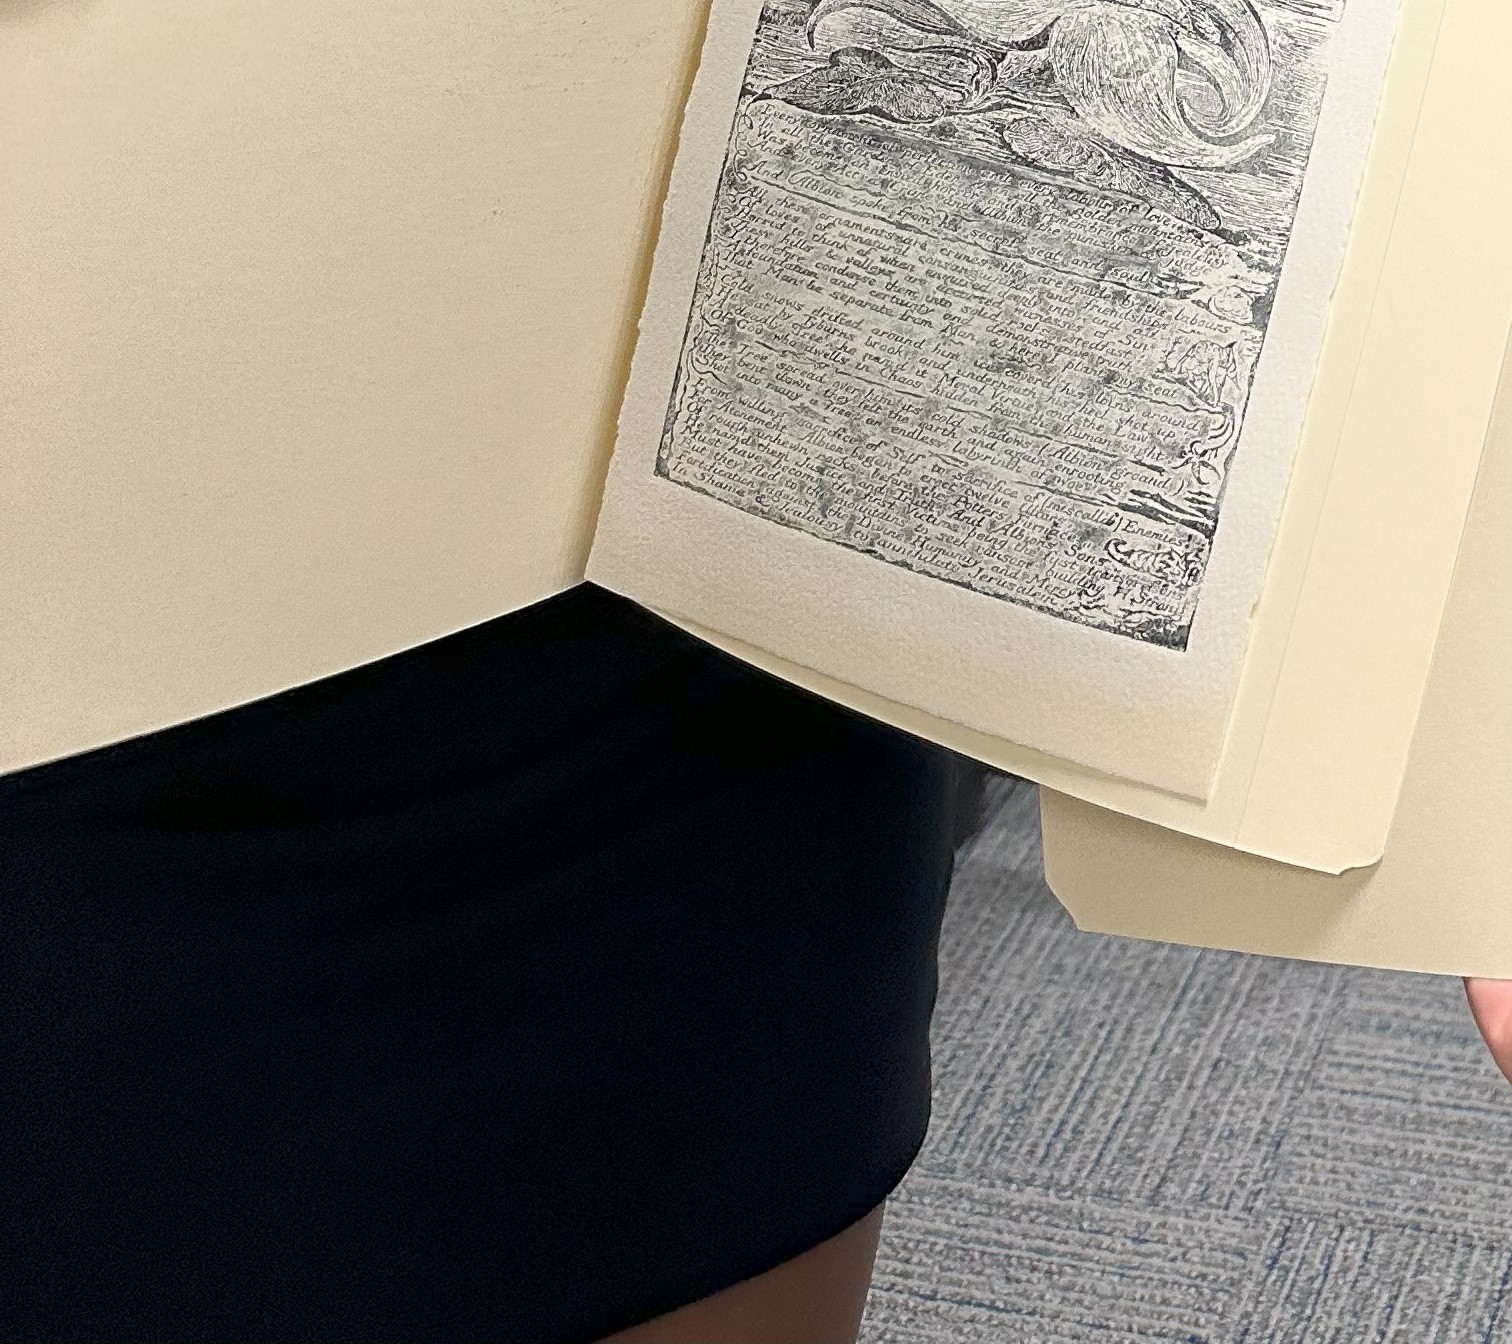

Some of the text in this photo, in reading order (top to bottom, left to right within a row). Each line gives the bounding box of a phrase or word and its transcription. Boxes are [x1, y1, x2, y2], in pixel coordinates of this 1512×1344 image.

[690, 375, 730, 400] From
[735, 317, 764, 335] God
[771, 331, 798, 348] who
[803, 341, 848, 366] dwells
[929, 381, 979, 407] hidden
[986, 399, 1022, 421] from
[737, 342, 769, 363] Tree
[775, 362, 826, 382] spread
[831, 377, 861, 396] over
[930, 412, 965, 428] cold
[870, 328, 926, 351] around
[1141, 410, 1201, 433] around
[918, 356, 951, 371] and
[735, 368, 762, 386] into
[764, 381, 803, 404] many
[889, 424, 945, 448] endless
[678, 423, 723, 449] Must
[726, 440, 763, 462] have
[830, 480, 854, 496] the
[966, 437, 997, 451] and
[692, 470, 746, 498] Shame
[745, 461, 781, 483] fled
[832, 498, 907, 528] mountains
[849, 445, 893, 470] began
[963, 485, 1011, 509] twelve
[856, 481, 888, 495] and
[990, 566, 1021, 580] and
